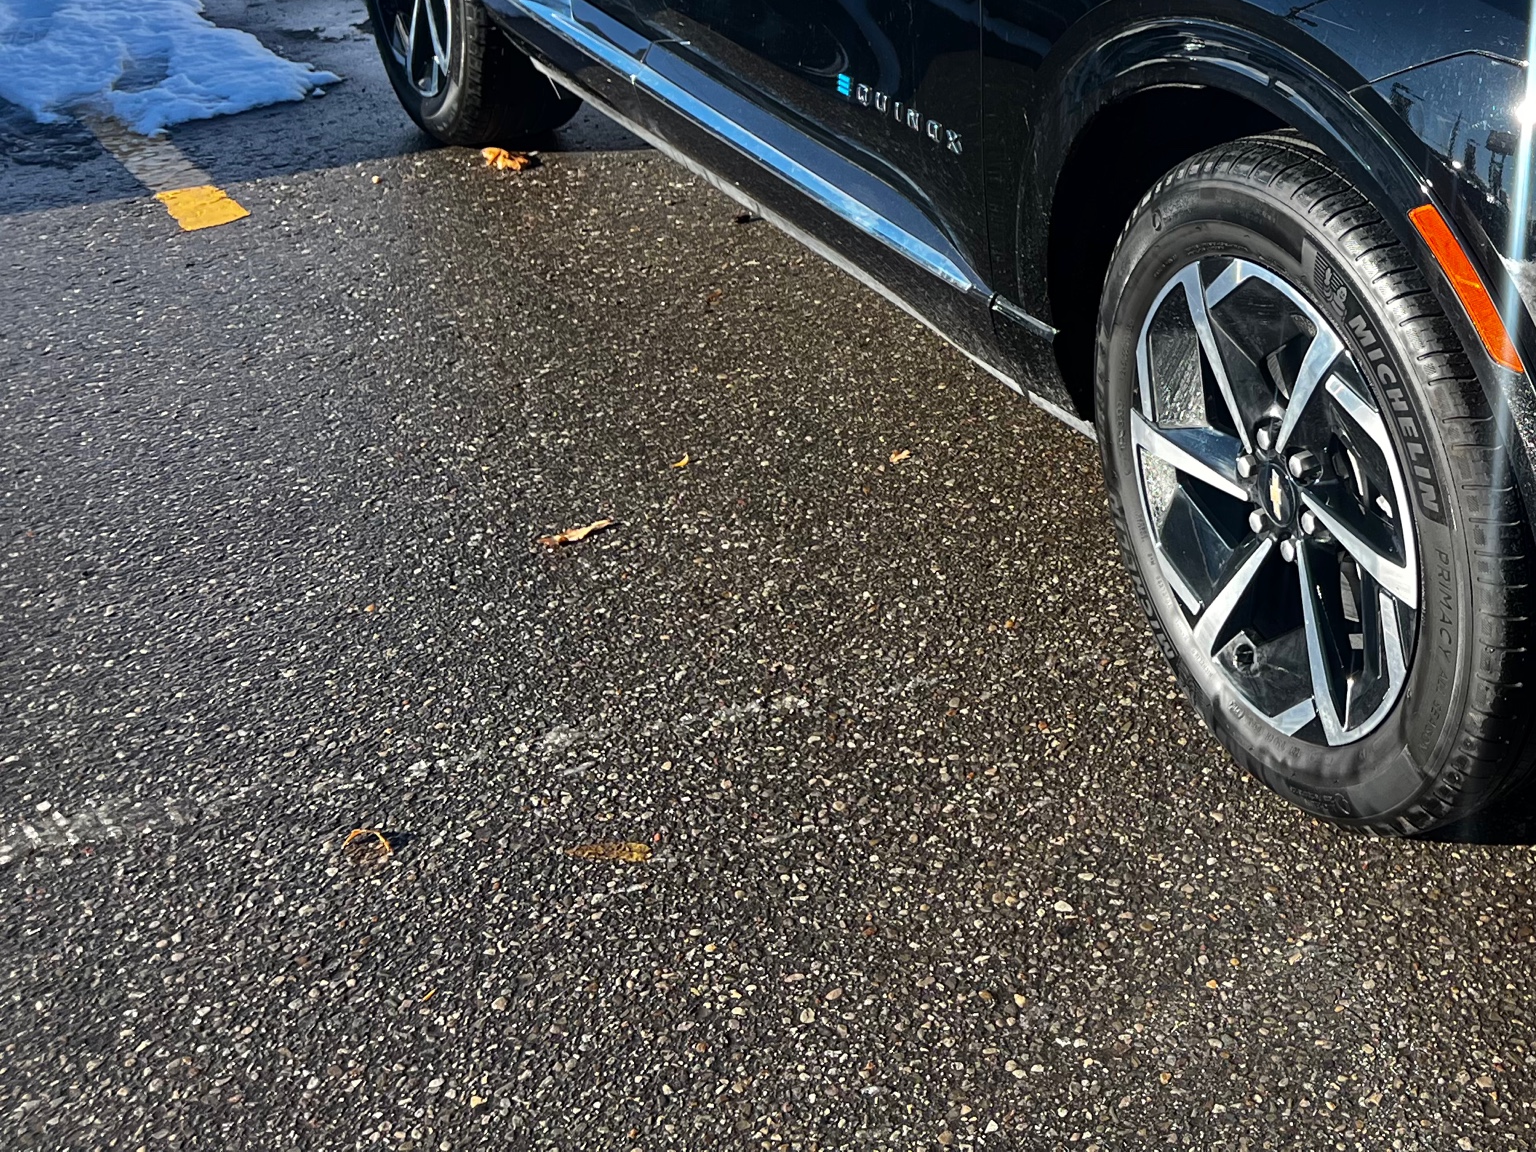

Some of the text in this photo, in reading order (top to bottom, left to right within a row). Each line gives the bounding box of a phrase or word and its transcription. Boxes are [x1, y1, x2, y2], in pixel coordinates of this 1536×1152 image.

[837, 73, 963, 155] EQUINOX
[1349, 314, 1439, 513] MICHELIN
[1434, 547, 1454, 664] PRIMACY
